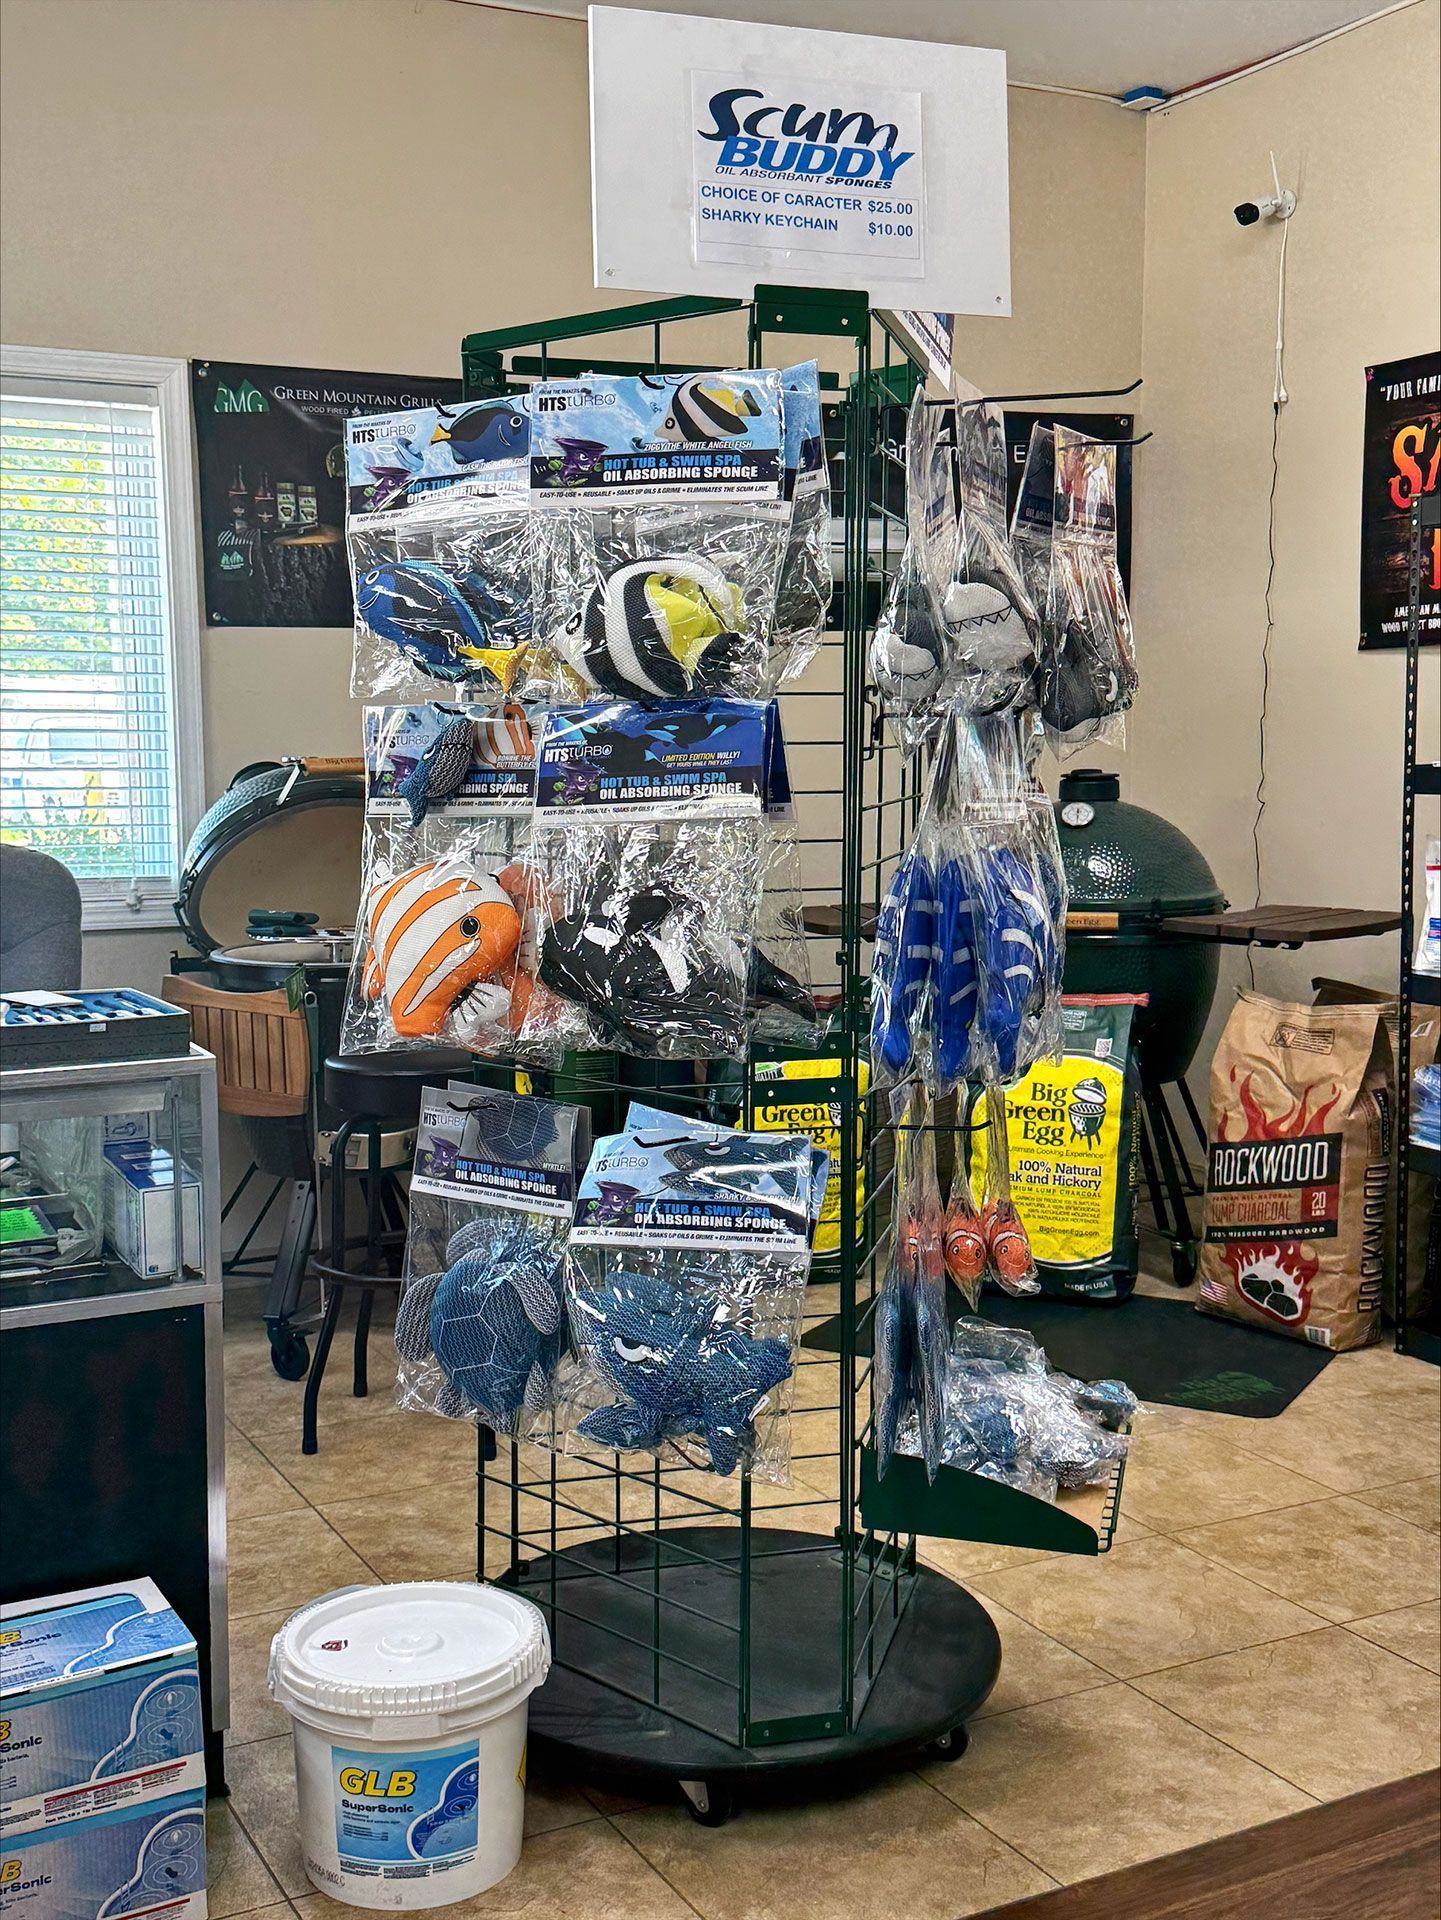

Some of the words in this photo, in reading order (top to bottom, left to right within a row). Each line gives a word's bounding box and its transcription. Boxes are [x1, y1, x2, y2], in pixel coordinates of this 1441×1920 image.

[696, 88, 899, 154] Scum
[716, 135, 915, 181] BUDDY
[714, 166, 737, 180] OIL
[740, 168, 824, 184] ABSORBANT
[824, 176, 893, 190] SPONGES
[700, 185, 758, 203] CHOICE
[760, 189, 781, 204] OF
[784, 192, 863, 212] CARACTER
[867, 199, 914, 216] $25.00
[701, 207, 762, 225] SHARKY
[764, 213, 839, 233] KEYCHAIN
[867, 222, 914, 238] $10.00
[214, 388, 264, 413] GMG
[301, 405, 326, 414] WOOD
[327, 407, 350, 415] FIRED
[666, 442, 682, 451] THE
[682, 441, 706, 450] WHITE
[603, 458, 630, 470] HOT
[632, 457, 658, 469] TUB
[659, 457, 668, 468] &
[670, 456, 712, 467] SWIM
[716, 454, 741, 466] SPA
[603, 471, 623, 483] OIL
[625, 467, 701, 481] ABSORBING
[704, 465, 758, 479] SPONGE
[689, 753, 715, 761] EDITION
[497, 773, 517, 783] SPA
[601, 777, 624, 789] HOT
[626, 776, 648, 787] TUB
[651, 775, 661, 786] &
[664, 774, 700, 785] SWIM
[703, 772, 727, 783] SPA
[460, 784, 488, 794] RBING
[490, 783, 529, 794] SPONGE
[600, 788, 620, 800] OIL
[620, 785, 691, 799] ABSORBING
[693, 783, 743, 796] SPONGE
[1031, 1083, 1068, 1107] Big
[761, 1104, 827, 1123] Green
[1023, 1121, 1065, 1146] Egg
[456, 1160, 476, 1171] HOT
[475, 1161, 496, 1174] TUB
[494, 1164, 501, 1175] &
[501, 1165, 527, 1179] SWIM
[527, 1170, 546, 1183] SPA
[1018, 1160, 1051, 1174] 100%
[1055, 1163, 1102, 1178] Natural
[1214, 1141, 1329, 1187] ROCKWOOD
[455, 1169, 469, 1180] OIL
[469, 1172, 520, 1189] ABSORBING
[520, 1181, 558, 1196] SPONGE
[1008, 1173, 1024, 1184] ak
[1026, 1174, 1050, 1185] and
[1052, 1175, 1103, 1191] Hickory
[1060, 1189, 1102, 1199] CHARCOAL
[1311, 1191, 1326, 1210] 20
[664, 1203, 689, 1215] TUB
[692, 1205, 700, 1215] &
[703, 1204, 741, 1217] SWIM
[1237, 1200, 1290, 1222] CHARCOAL
[656, 1215, 734, 1228] ABSORBING
[734, 1216, 787, 1231] SPONGE
[1229, 1230, 1267, 1238] MISSOURI
[1269, 1226, 1326, 1237] HARDWOOD
[1357, 1163, 1390, 1314] ROCKWOOD
[1093, 1281, 1109, 1290] USA
[340, 1767, 418, 1798] GLB
[341, 1798, 415, 1815] SuperSonic
